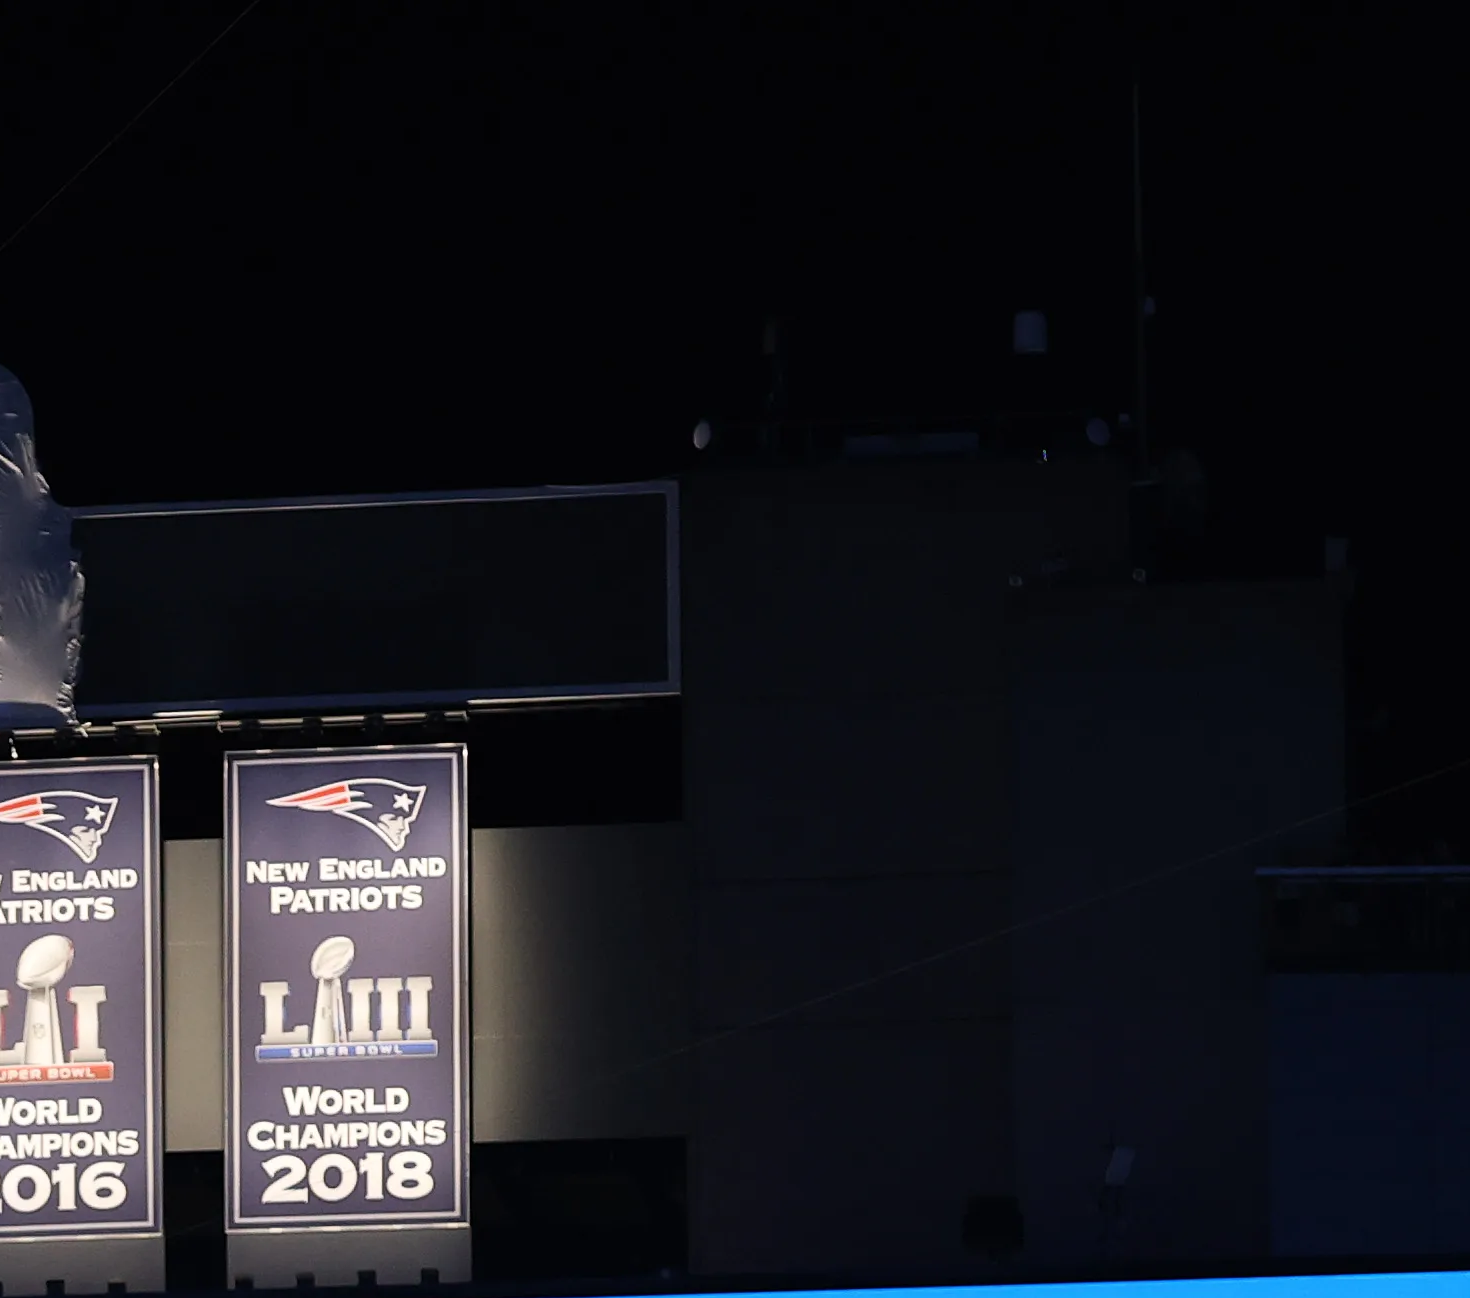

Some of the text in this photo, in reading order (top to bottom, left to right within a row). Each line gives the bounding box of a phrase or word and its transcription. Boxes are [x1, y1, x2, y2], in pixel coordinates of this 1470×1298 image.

[12, 869, 138, 893] ENGLAND
[246, 857, 447, 883] NEW ENGLAND
[270, 886, 423, 914] PATRIOTS
[290, 1043, 404, 1058] SUPER BOWL
[47, 1066, 100, 1081] BOWL
[283, 1086, 409, 1116] WORLD
[247, 1120, 446, 1151] CHAMPIONS
[262, 1151, 433, 1203] 2018
